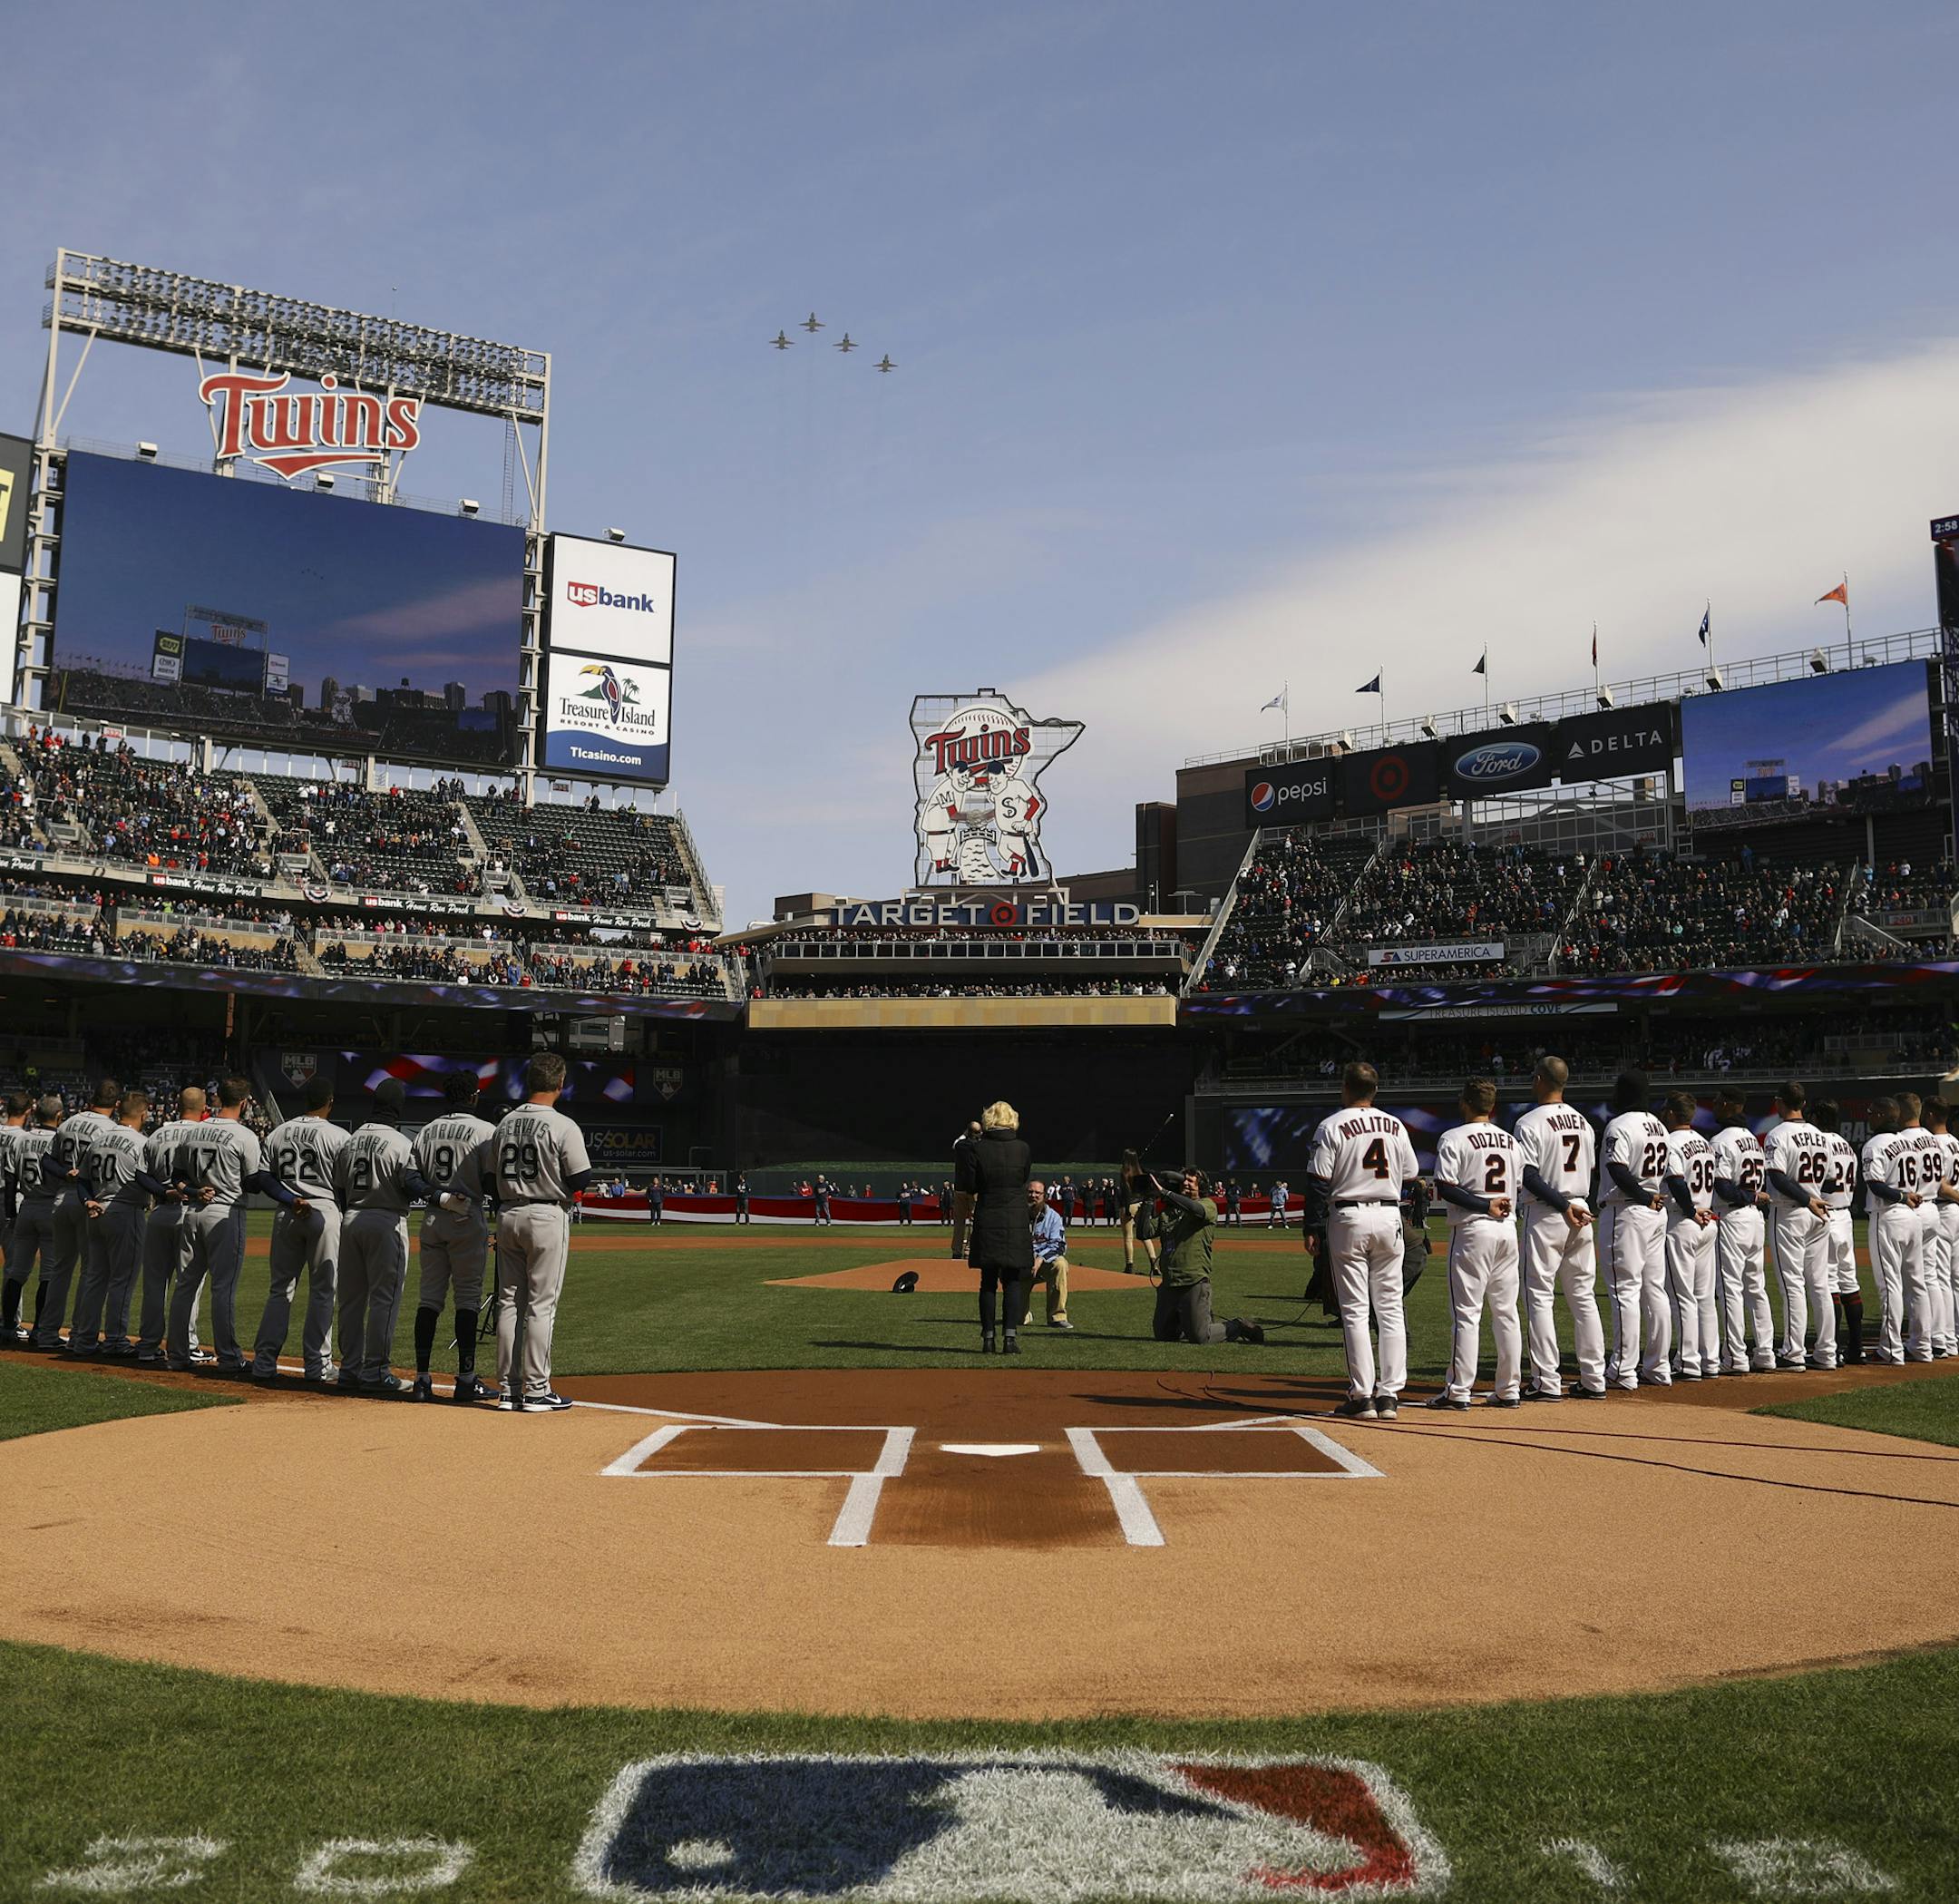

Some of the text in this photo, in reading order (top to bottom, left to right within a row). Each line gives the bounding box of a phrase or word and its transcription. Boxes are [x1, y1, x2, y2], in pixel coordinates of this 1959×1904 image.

[199, 373, 421, 461] Twins
[1935, 520, 1958, 533] 2:58
[559, 697, 655, 727] Treasure Island
[560, 718, 599, 728] RESORT
[616, 726, 655, 736] CASINO
[925, 724, 1030, 776] Twins
[1591, 729, 1662, 755] DELTA
[1471, 747, 1523, 776] Ford
[1278, 776, 1327, 806] pepsi
[11, 857, 36, 871] Porch
[193, 879, 216, 893] Home
[217, 883, 233, 894] Run
[235, 884, 257, 897] Porch
[404, 900, 427, 912] Home
[429, 902, 445, 913] Run
[448, 903, 470, 914] Porch
[592, 913, 613, 925] Home
[615, 916, 629, 927] Run
[631, 917, 652, 928] Porch
[831, 903, 1140, 926] TARGET FIELD
[1404, 946, 1492, 962] SUPERAMERICA
[1428, 1003, 1562, 1019] TREASURE ISLAND COVE
[285, 1055, 315, 1066] MLB
[656, 1070, 681, 1079] MLB
[284, 1127, 317, 1142] CANO
[423, 1123, 475, 1144] GORDON
[1339, 1116, 1400, 1141] MOLITOR
[1546, 1114, 1587, 1132] MAUER
[602, 1148, 657, 1158] us-solar.com
[1467, 1132, 1514, 1151] DOZIER
[1562, 1134, 1580, 1173] 7
[1791, 1132, 1827, 1148] KEPLER
[192, 1147, 218, 1179] 17
[279, 1148, 318, 1180] 22
[434, 1146, 454, 1181] 9
[501, 1143, 540, 1180] 29
[1362, 1138, 1389, 1179] 4
[1485, 1153, 1506, 1193] 2
[1642, 1142, 1669, 1178] 22
[1798, 1152, 1828, 1184] 26
[1897, 1156, 1916, 1188] 16
[1922, 1153, 1942, 1183] 99
[353, 1157, 373, 1190] 2
[1691, 1159, 1714, 1194] 36
[1740, 1158, 1764, 1192] 25
[1835, 1161, 1855, 1193] 24
